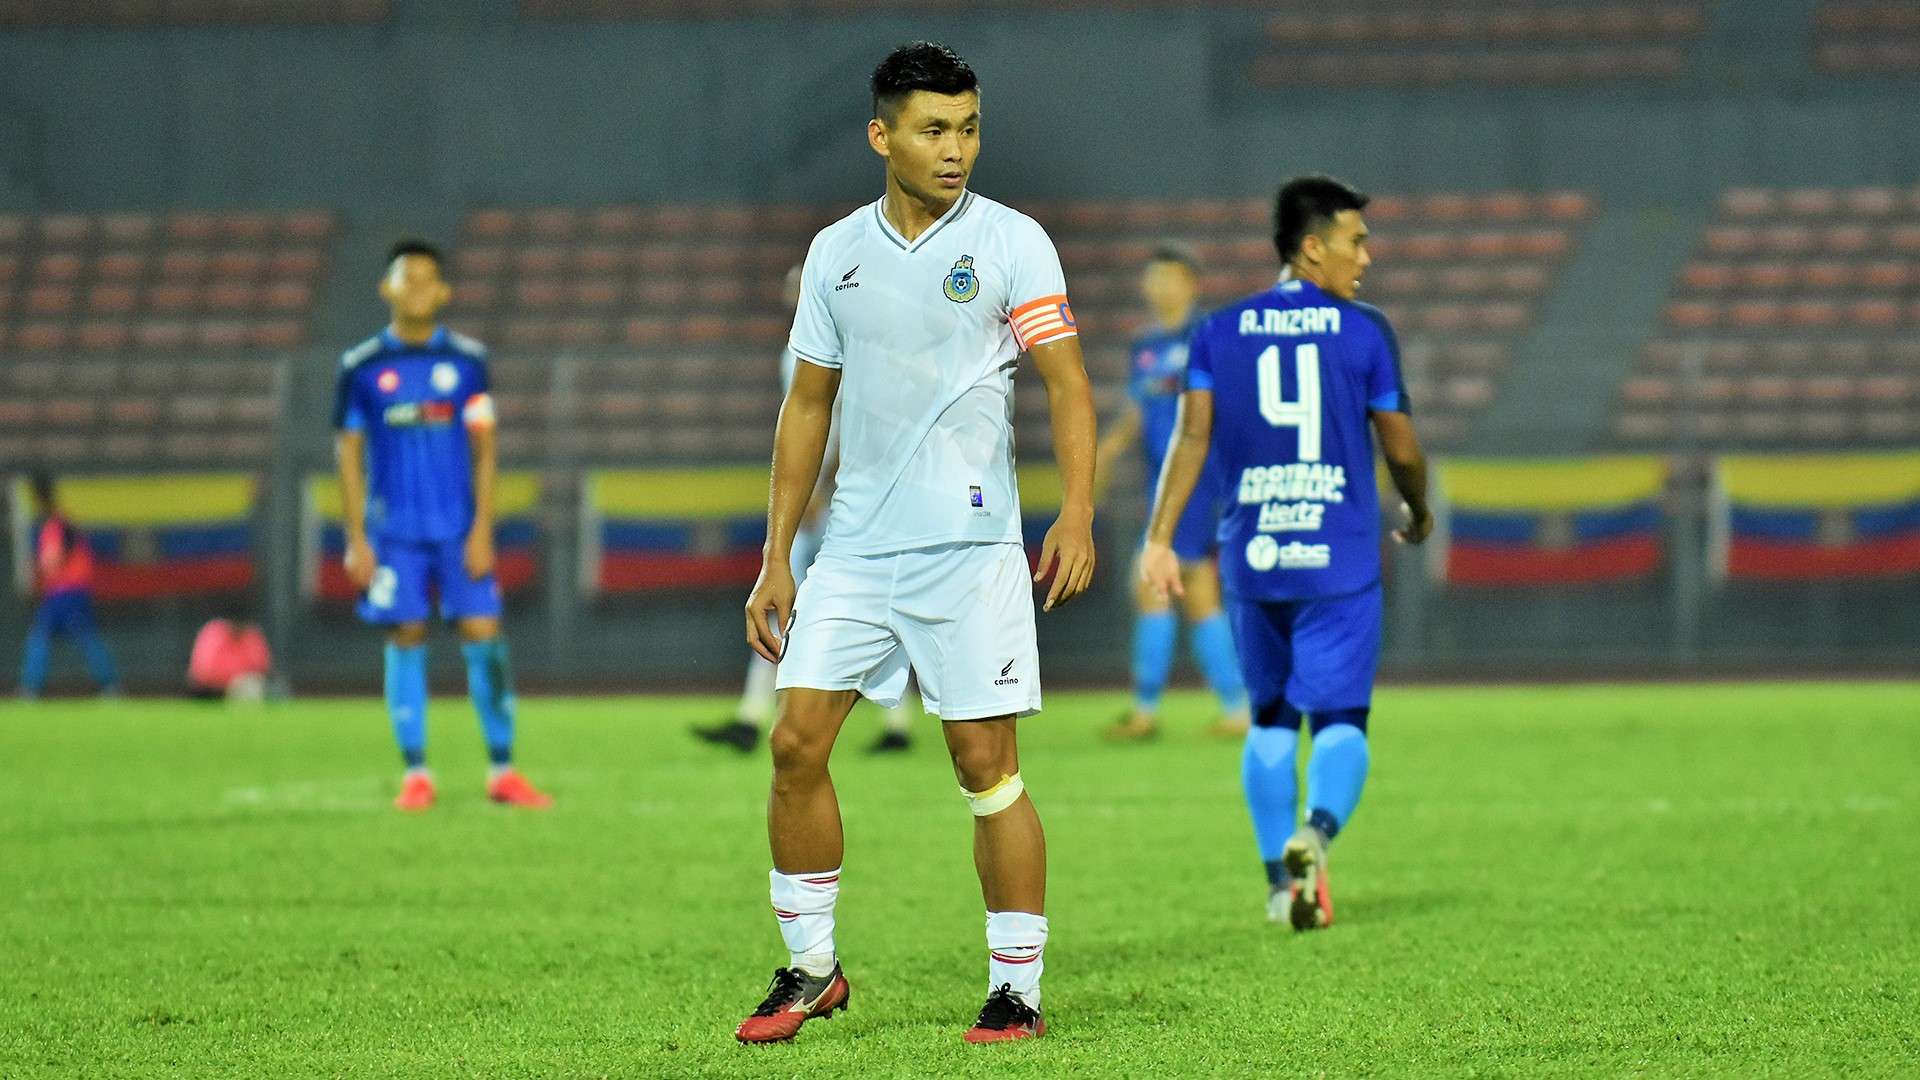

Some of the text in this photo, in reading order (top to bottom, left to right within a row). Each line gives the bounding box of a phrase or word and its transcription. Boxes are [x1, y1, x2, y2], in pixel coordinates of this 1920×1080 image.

[835, 281, 860, 291] carino
[1239, 307, 1341, 335] A.NIZAM
[1257, 343, 1322, 462] 4
[1242, 464, 1346, 485] FOOTBALL
[1258, 501, 1325, 523] Hertz
[994, 677, 1019, 686] carino
